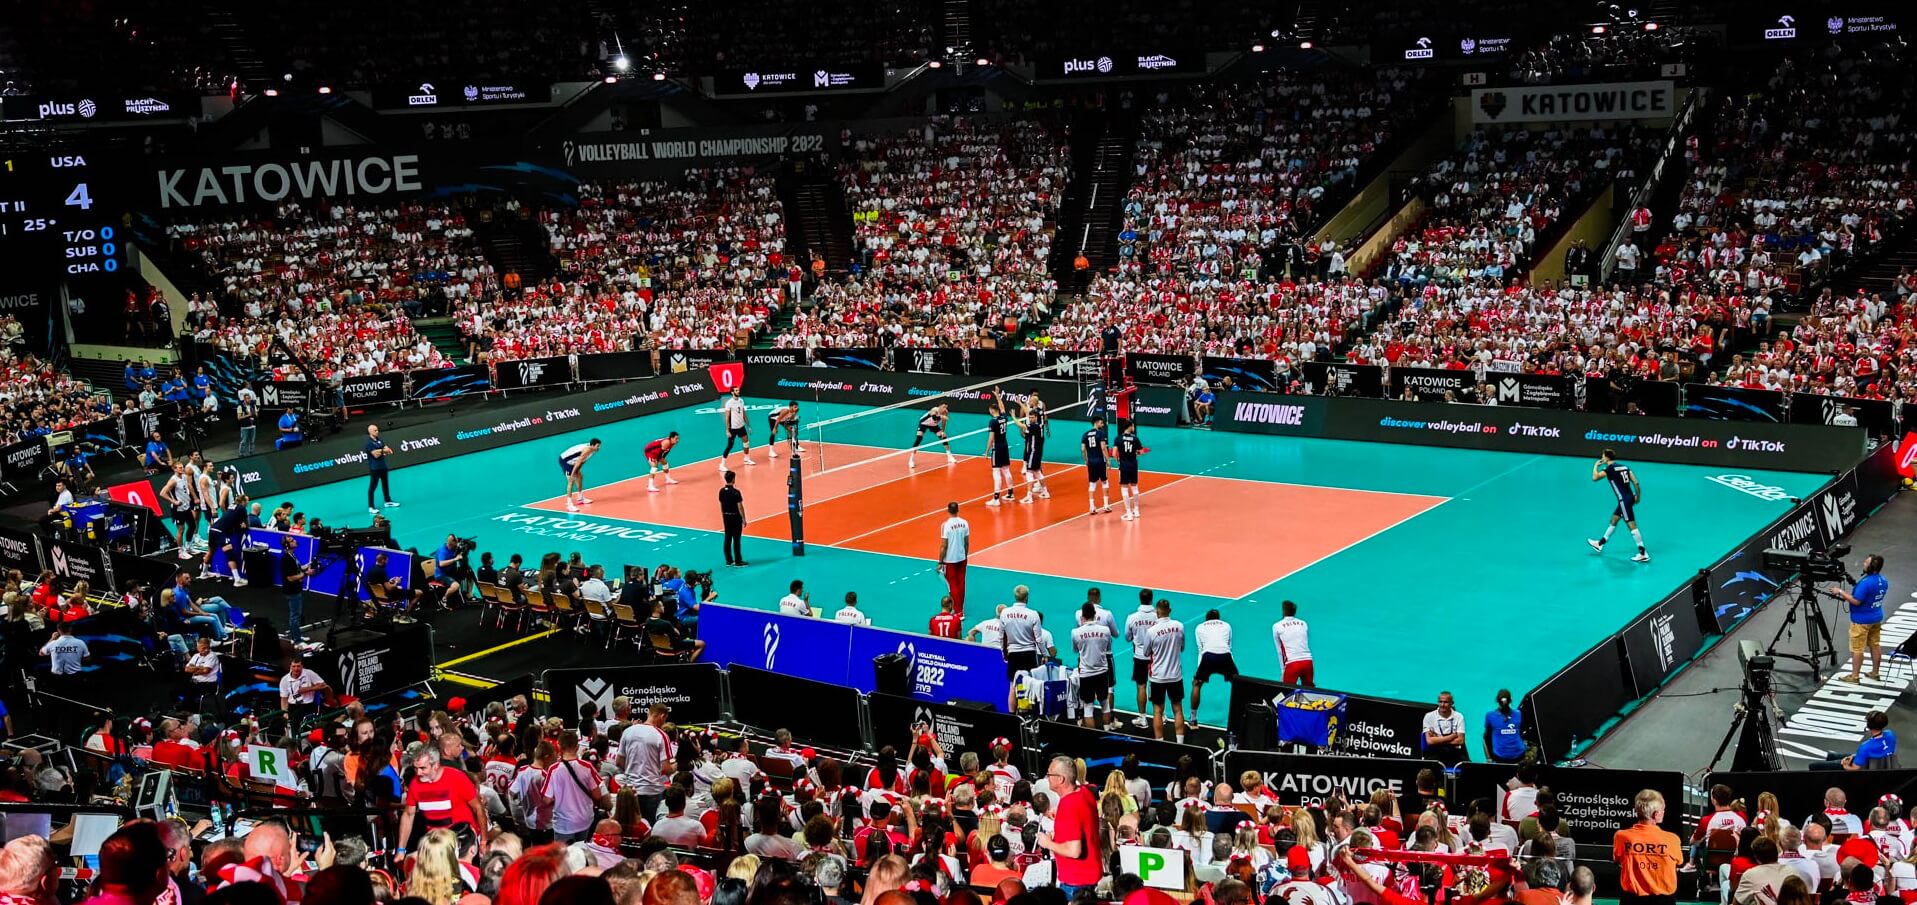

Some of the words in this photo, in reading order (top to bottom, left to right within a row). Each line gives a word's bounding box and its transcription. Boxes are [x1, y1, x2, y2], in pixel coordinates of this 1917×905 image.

[1064, 58, 1094, 74] plus
[1670, 65, 1678, 75] J
[1470, 74, 1480, 84] H
[39, 100, 75, 118] plus
[1522, 89, 1666, 116] KATOWICE
[578, 142, 649, 162] VOLLEYBALL
[652, 140, 697, 160] WORLD
[700, 136, 788, 158] CHAMPIONSHIP
[792, 135, 824, 152] 2022
[5, 160, 14, 172] 1
[50, 156, 86, 168] USA
[158, 154, 422, 208] KATOWICE
[64, 182, 94, 210] 4
[24, 218, 47, 232] 25
[62, 230, 96, 243] T/O
[100, 226, 114, 240] 0
[66, 246, 98, 258] SUB
[102, 242, 116, 256] 0
[67, 262, 100, 274] CHA
[104, 258, 118, 272] 0
[748, 355, 796, 364] KATOWICE
[1136, 360, 1183, 372] KATOWICE
[722, 369, 733, 388] 0
[778, 378, 808, 388] discover
[808, 380, 843, 392] volleyball
[868, 384, 894, 394] TikTok
[1404, 376, 1462, 388] KATOWICE
[345, 380, 392, 393] ATOWICE
[352, 390, 378, 398] POLAND
[1418, 386, 1446, 394] POLAND
[594, 400, 625, 412] discover
[624, 392, 658, 407] volleyball
[680, 382, 704, 394] TikTok
[1234, 402, 1304, 426] KATOWICE
[456, 427, 492, 440] discover
[492, 417, 532, 434] volleyball
[531, 417, 543, 425] on
[553, 408, 580, 420] TikTok
[1380, 416, 1426, 430] discover
[1428, 420, 1481, 434] volleyball
[1482, 426, 1497, 434] on
[1522, 424, 1560, 438] TikTok
[410, 436, 440, 450] TikTok
[1124, 442, 1132, 453] 14
[1584, 430, 1636, 443] discover
[1638, 434, 1699, 449] volleyball
[1702, 438, 1718, 448] on
[1742, 439, 1785, 453] TikTok
[7, 444, 42, 464] KATOWICE
[18, 458, 34, 468] POLAND
[294, 458, 334, 474] discover
[334, 450, 368, 465] volleyb
[242, 472, 262, 484] 2022
[1620, 471, 1630, 484] 15
[490, 512, 678, 542] KATOWICE
[512, 525, 598, 542] POLAND
[1771, 511, 1816, 550] KATOWICE
[938, 622, 951, 636] 17
[1157, 628, 1179, 636] POLSKA
[357, 656, 379, 668] POLAND
[917, 658, 933, 666] WORLD
[918, 652, 946, 661] VOLLEYBALL
[358, 663, 384, 677] SLOVENIA
[916, 665, 944, 686] 2022
[359, 674, 373, 686] 2022
[622, 684, 677, 696] Górnośląsko
[936, 722, 959, 736] POLAND
[1348, 722, 1394, 738] ośląsko
[938, 733, 965, 746] SLOVENIA
[1336, 736, 1412, 756] agłębiowska
[258, 750, 278, 776] R
[1263, 772, 1403, 798] KATOWICE
[1557, 792, 1629, 806] Górnośląsko
[1558, 804, 1638, 819] -Zagłębiowsk
[1139, 852, 1165, 880] P
